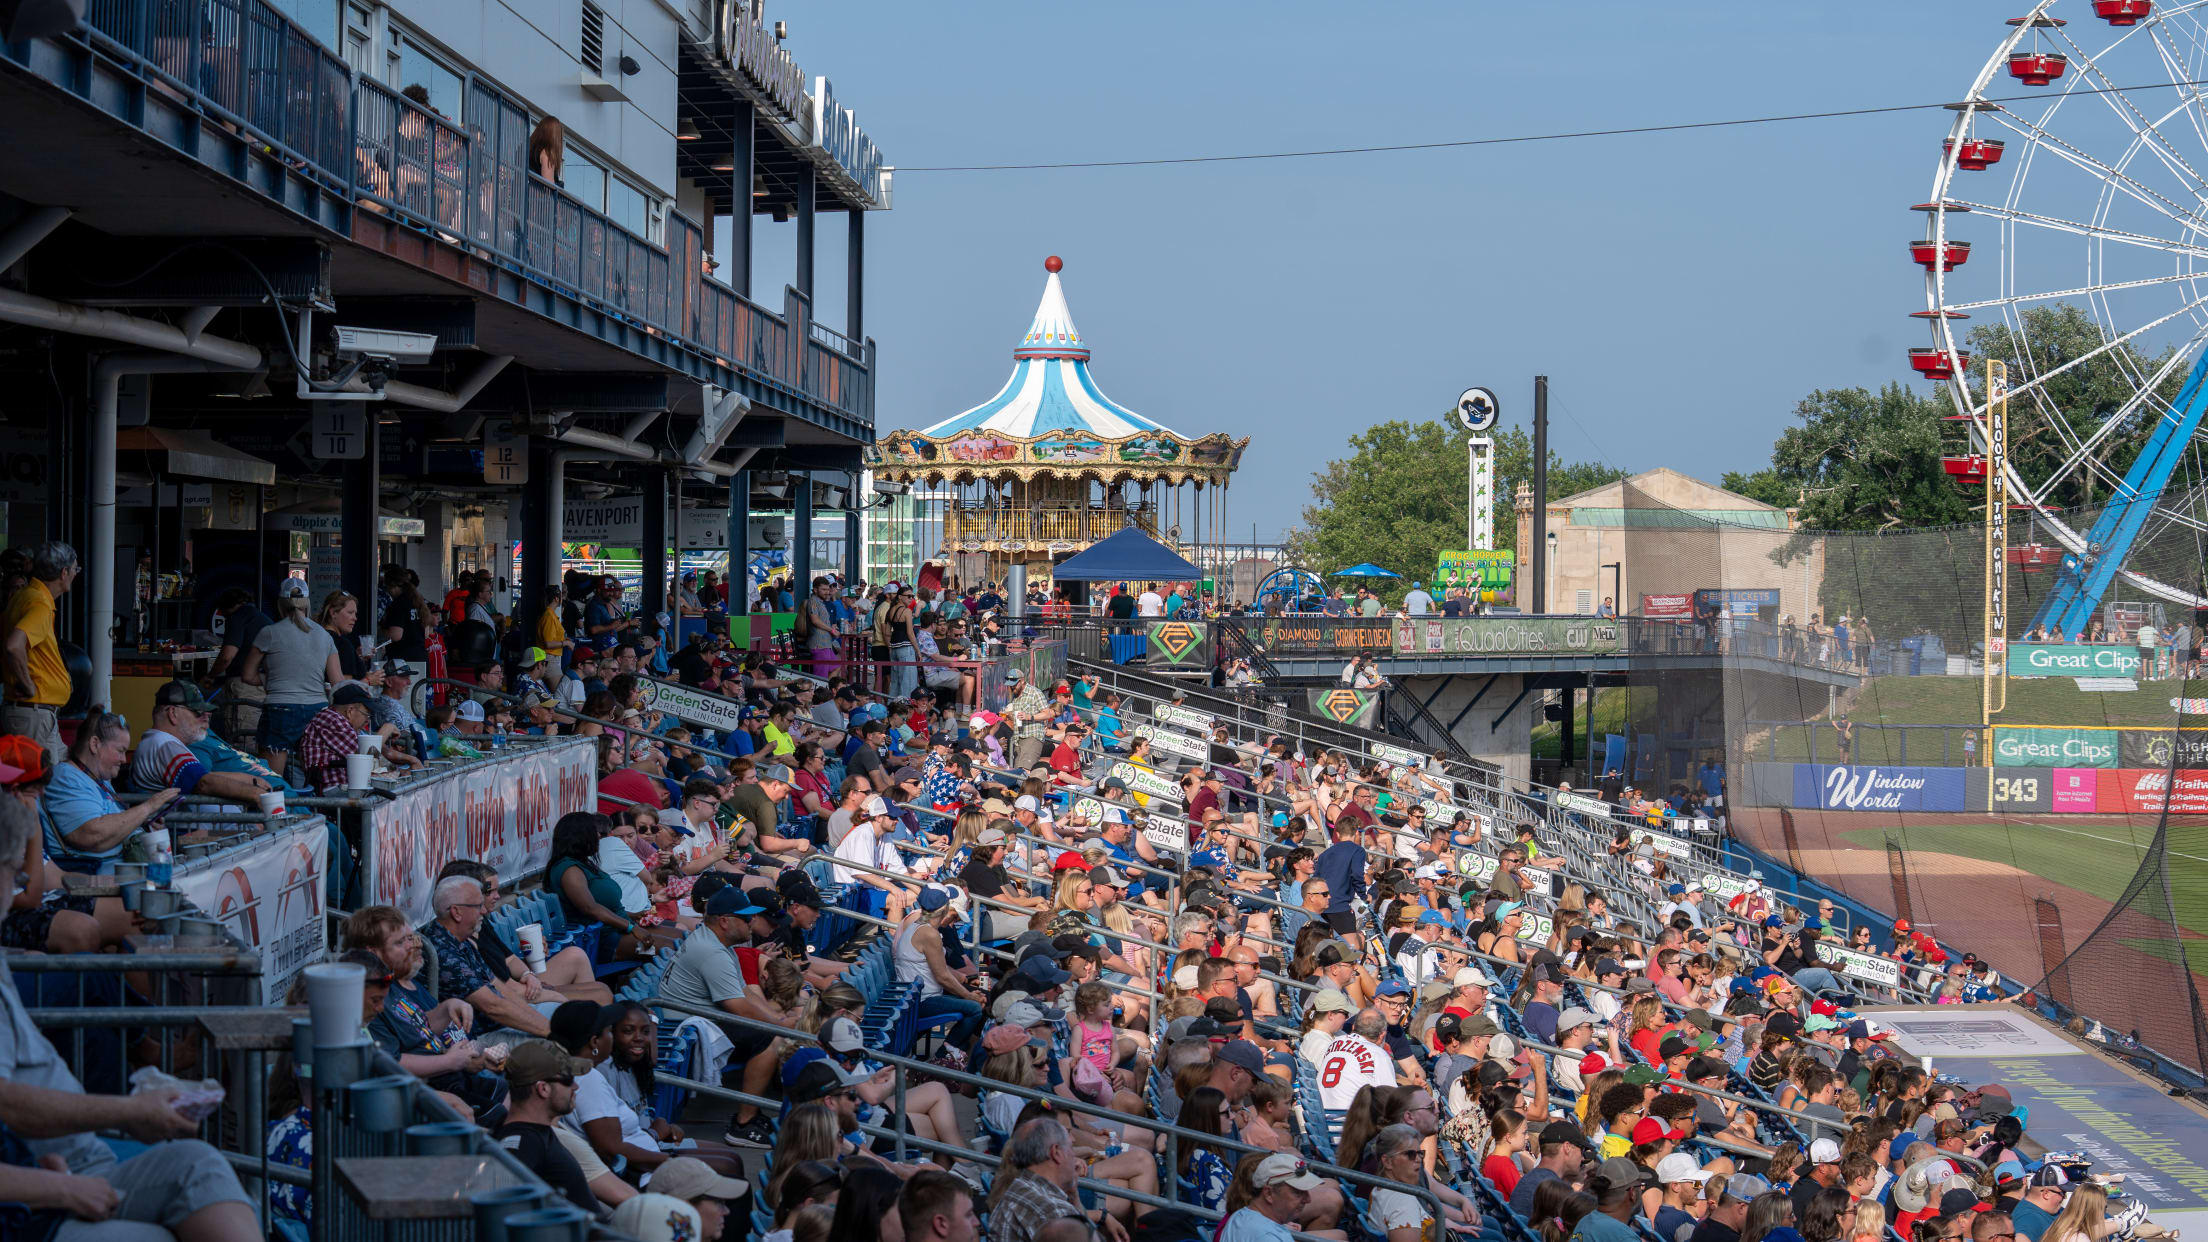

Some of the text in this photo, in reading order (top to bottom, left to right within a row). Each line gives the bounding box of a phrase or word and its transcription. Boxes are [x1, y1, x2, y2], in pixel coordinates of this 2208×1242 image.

[333, 414, 345, 431] 11
[330, 438, 346, 453] 10
[1993, 414, 2003, 470] ROOT
[499, 447, 512, 462] 12
[500, 466, 510, 480] 11
[1993, 476, 2002, 494] 4
[331, 518, 344, 528] do
[562, 505, 639, 526] AVENPORT
[1445, 551, 1507, 560] FROG HOPPER
[1734, 591, 1770, 601] TICKETS
[1278, 628, 1321, 640] DIAMOND
[1335, 628, 1373, 647] CORNFIELD
[1373, 628, 1393, 647] DECK
[1428, 624, 1442, 636] FOX
[1429, 638, 1441, 649] 18
[2030, 649, 2142, 673] Great Clips
[659, 687, 737, 720] GreenState
[657, 701, 724, 726] CREDIT UNION
[1172, 709, 1209, 726] GreenSta
[1154, 740, 1199, 756] CREDIT UNION
[1155, 731, 1207, 752] GreenState
[1998, 738, 2111, 763] Great Clips
[1386, 745, 1424, 763] GreenState
[1136, 772, 1186, 800] GreenSta
[1995, 778, 2038, 802] 343
[2174, 779, 2208, 789] Trailw
[1572, 796, 1610, 812] GreenState
[1652, 837, 1690, 852] reenState
[1485, 860, 1549, 885] GState
[1722, 880, 1773, 901] Greete
[1833, 950, 1896, 976] GeenState
[1861, 969, 1887, 981] UNION
[1324, 1039, 1375, 1074] STRZEMSKI
[1321, 1056, 1347, 1089] 8
